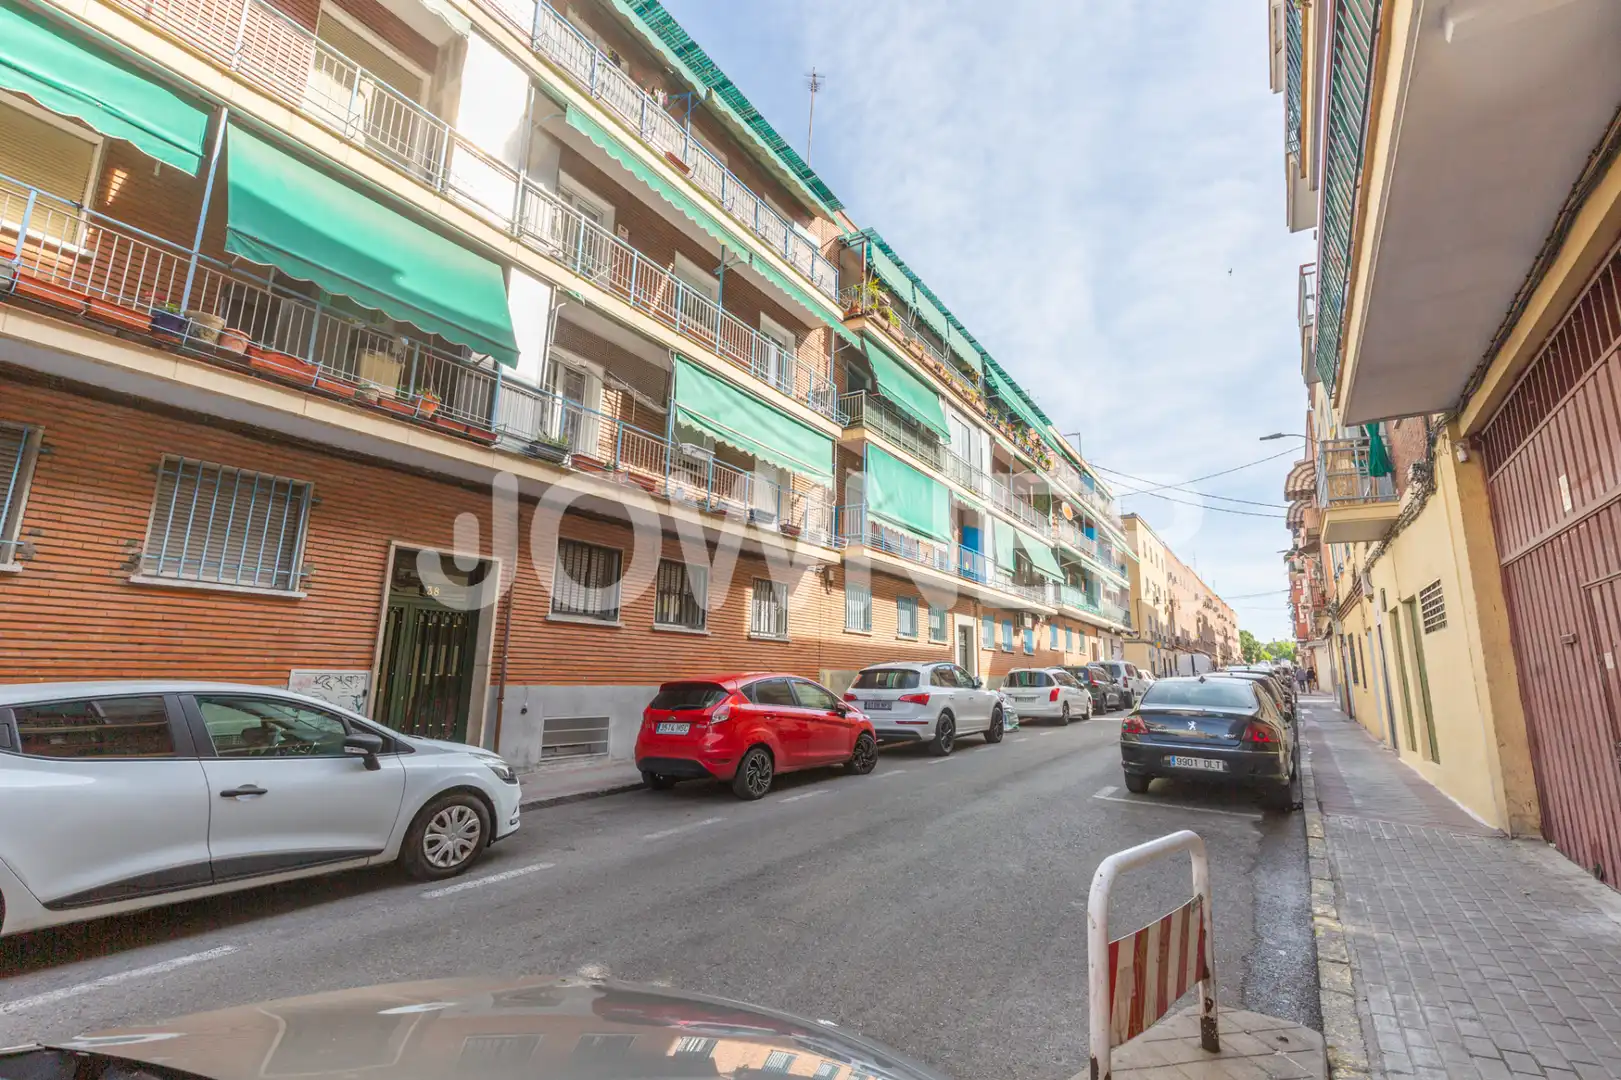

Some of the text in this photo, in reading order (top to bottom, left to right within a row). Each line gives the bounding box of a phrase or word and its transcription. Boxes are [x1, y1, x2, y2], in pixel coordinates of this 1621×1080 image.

[427, 586, 440, 596] 38
[1176, 757, 1221, 769] 9901 DLT
